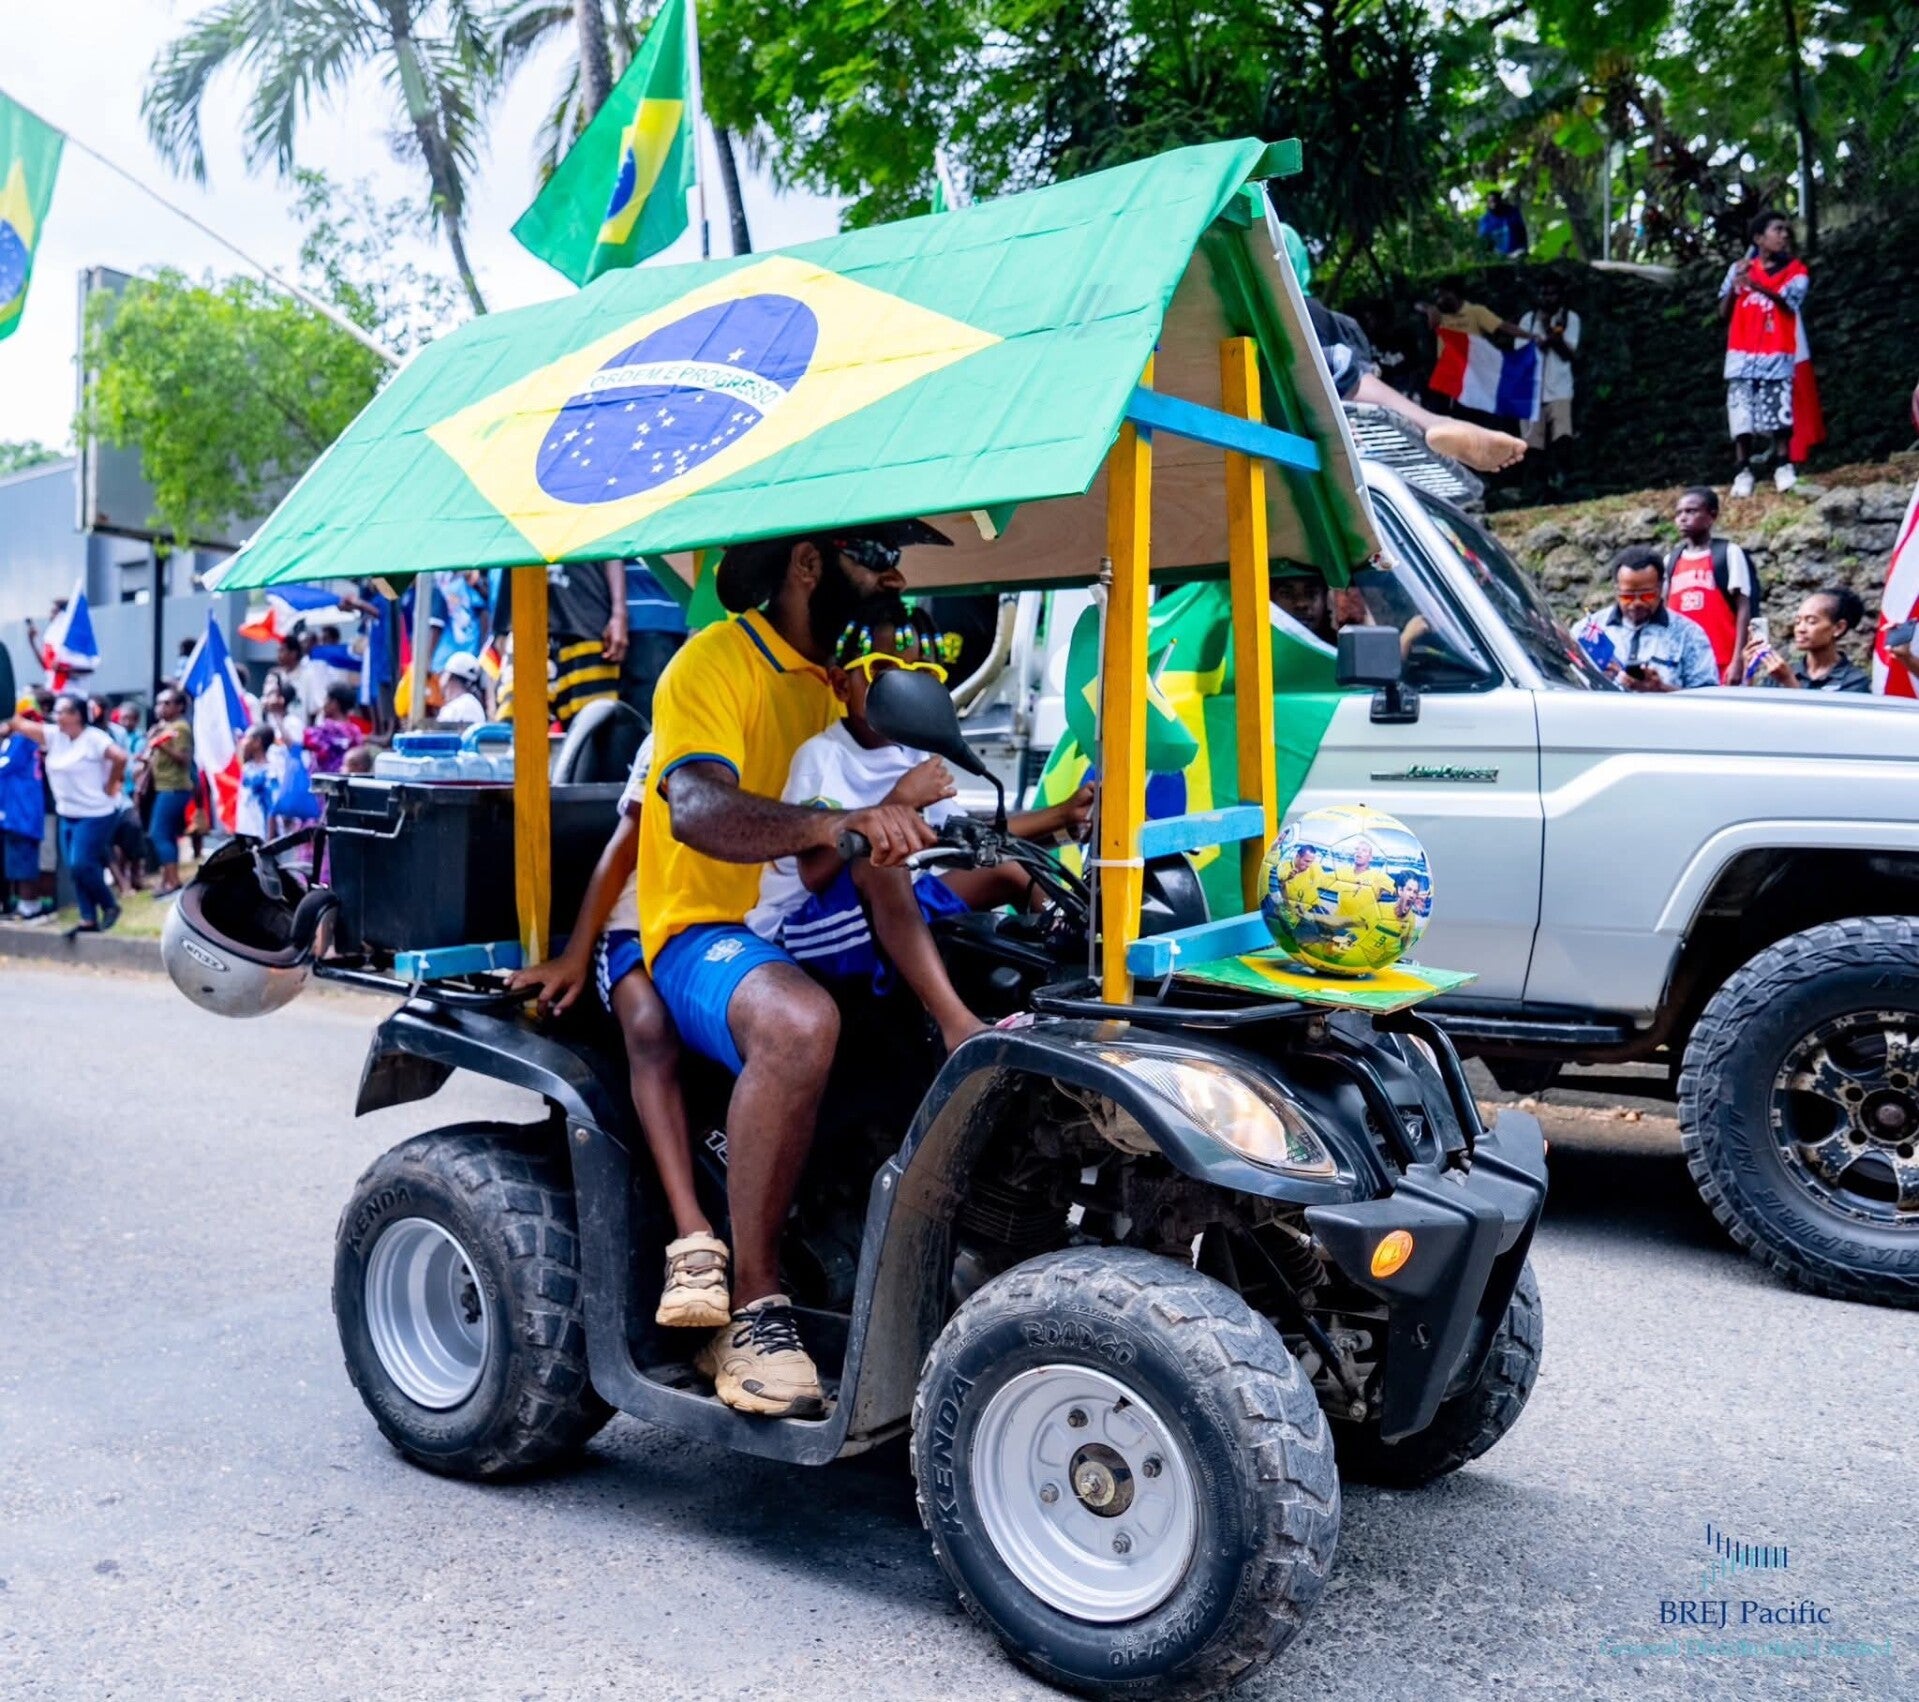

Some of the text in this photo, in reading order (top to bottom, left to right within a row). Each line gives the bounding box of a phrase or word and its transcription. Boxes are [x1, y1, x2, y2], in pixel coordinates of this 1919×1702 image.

[590, 366, 661, 389] ORDEM
[663, 366, 677, 380] E
[347, 1187, 412, 1253] KENDA
[1023, 1319, 1137, 1368] ROADGO
[932, 1373, 975, 1536] KENDA
